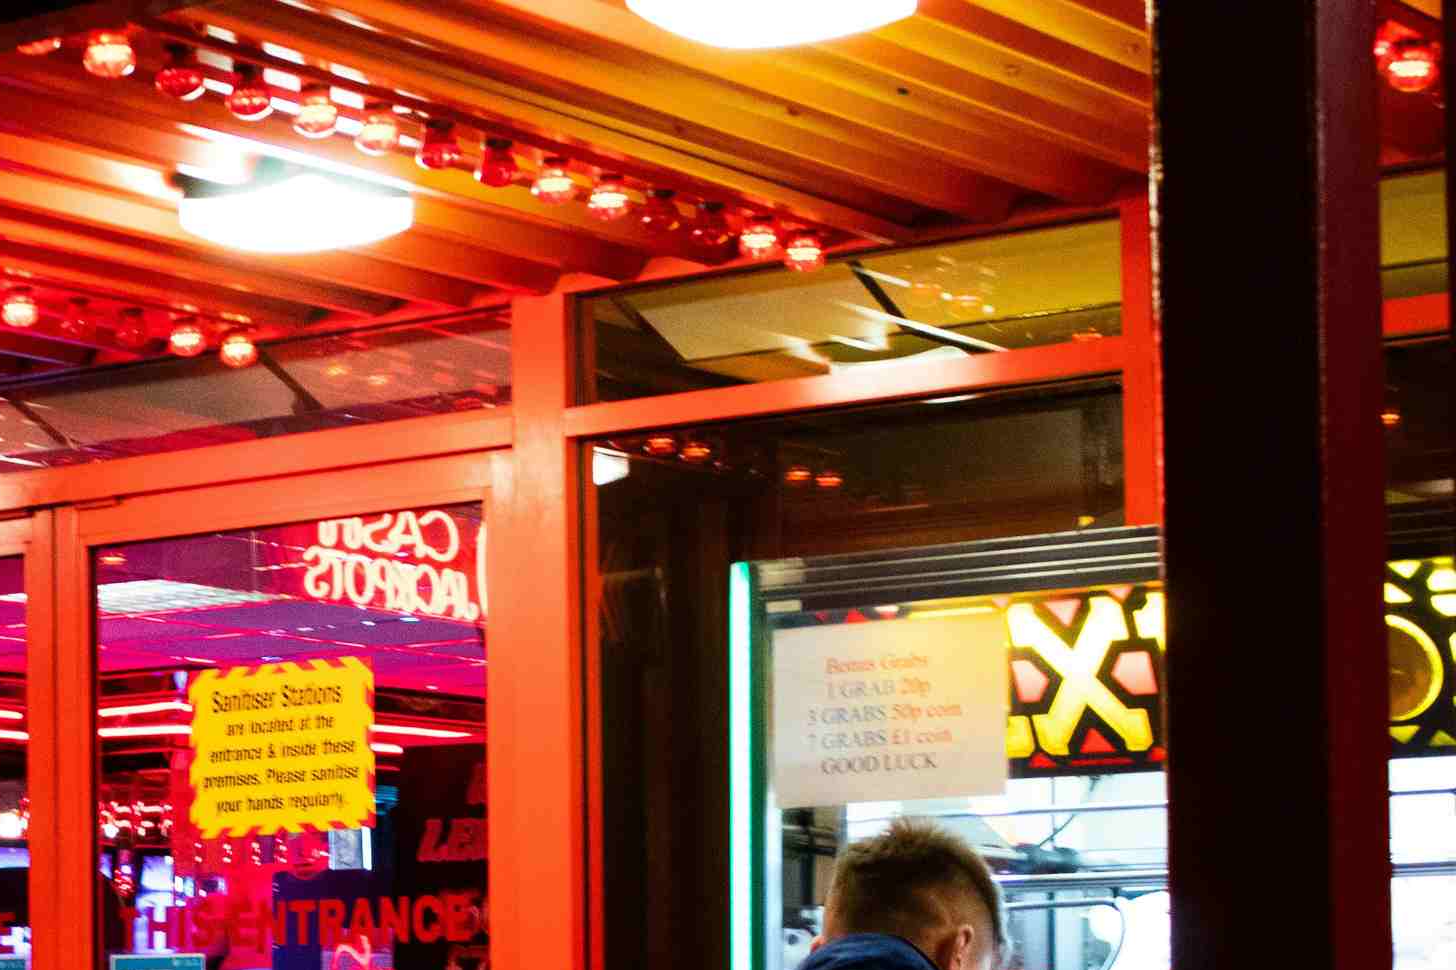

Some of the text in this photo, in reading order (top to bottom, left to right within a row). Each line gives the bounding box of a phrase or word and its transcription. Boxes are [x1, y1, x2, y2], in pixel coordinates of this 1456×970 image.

[825, 654, 929, 674] Bonus Grabs
[211, 684, 342, 713] Sanitiser Stations
[839, 679, 895, 699] GRAB
[820, 704, 888, 725] GRABS
[250, 719, 294, 735] located
[821, 729, 889, 750] GRABS
[210, 746, 263, 763] entrance
[282, 743, 317, 758] inside
[322, 739, 356, 754] these
[266, 767, 307, 784] Please
[311, 764, 360, 782] sanitise
[820, 752, 939, 776] GOOD LUCK
[216, 799, 242, 816] your
[247, 796, 284, 811] hands
[232, 896, 474, 952] ENTRANCE
